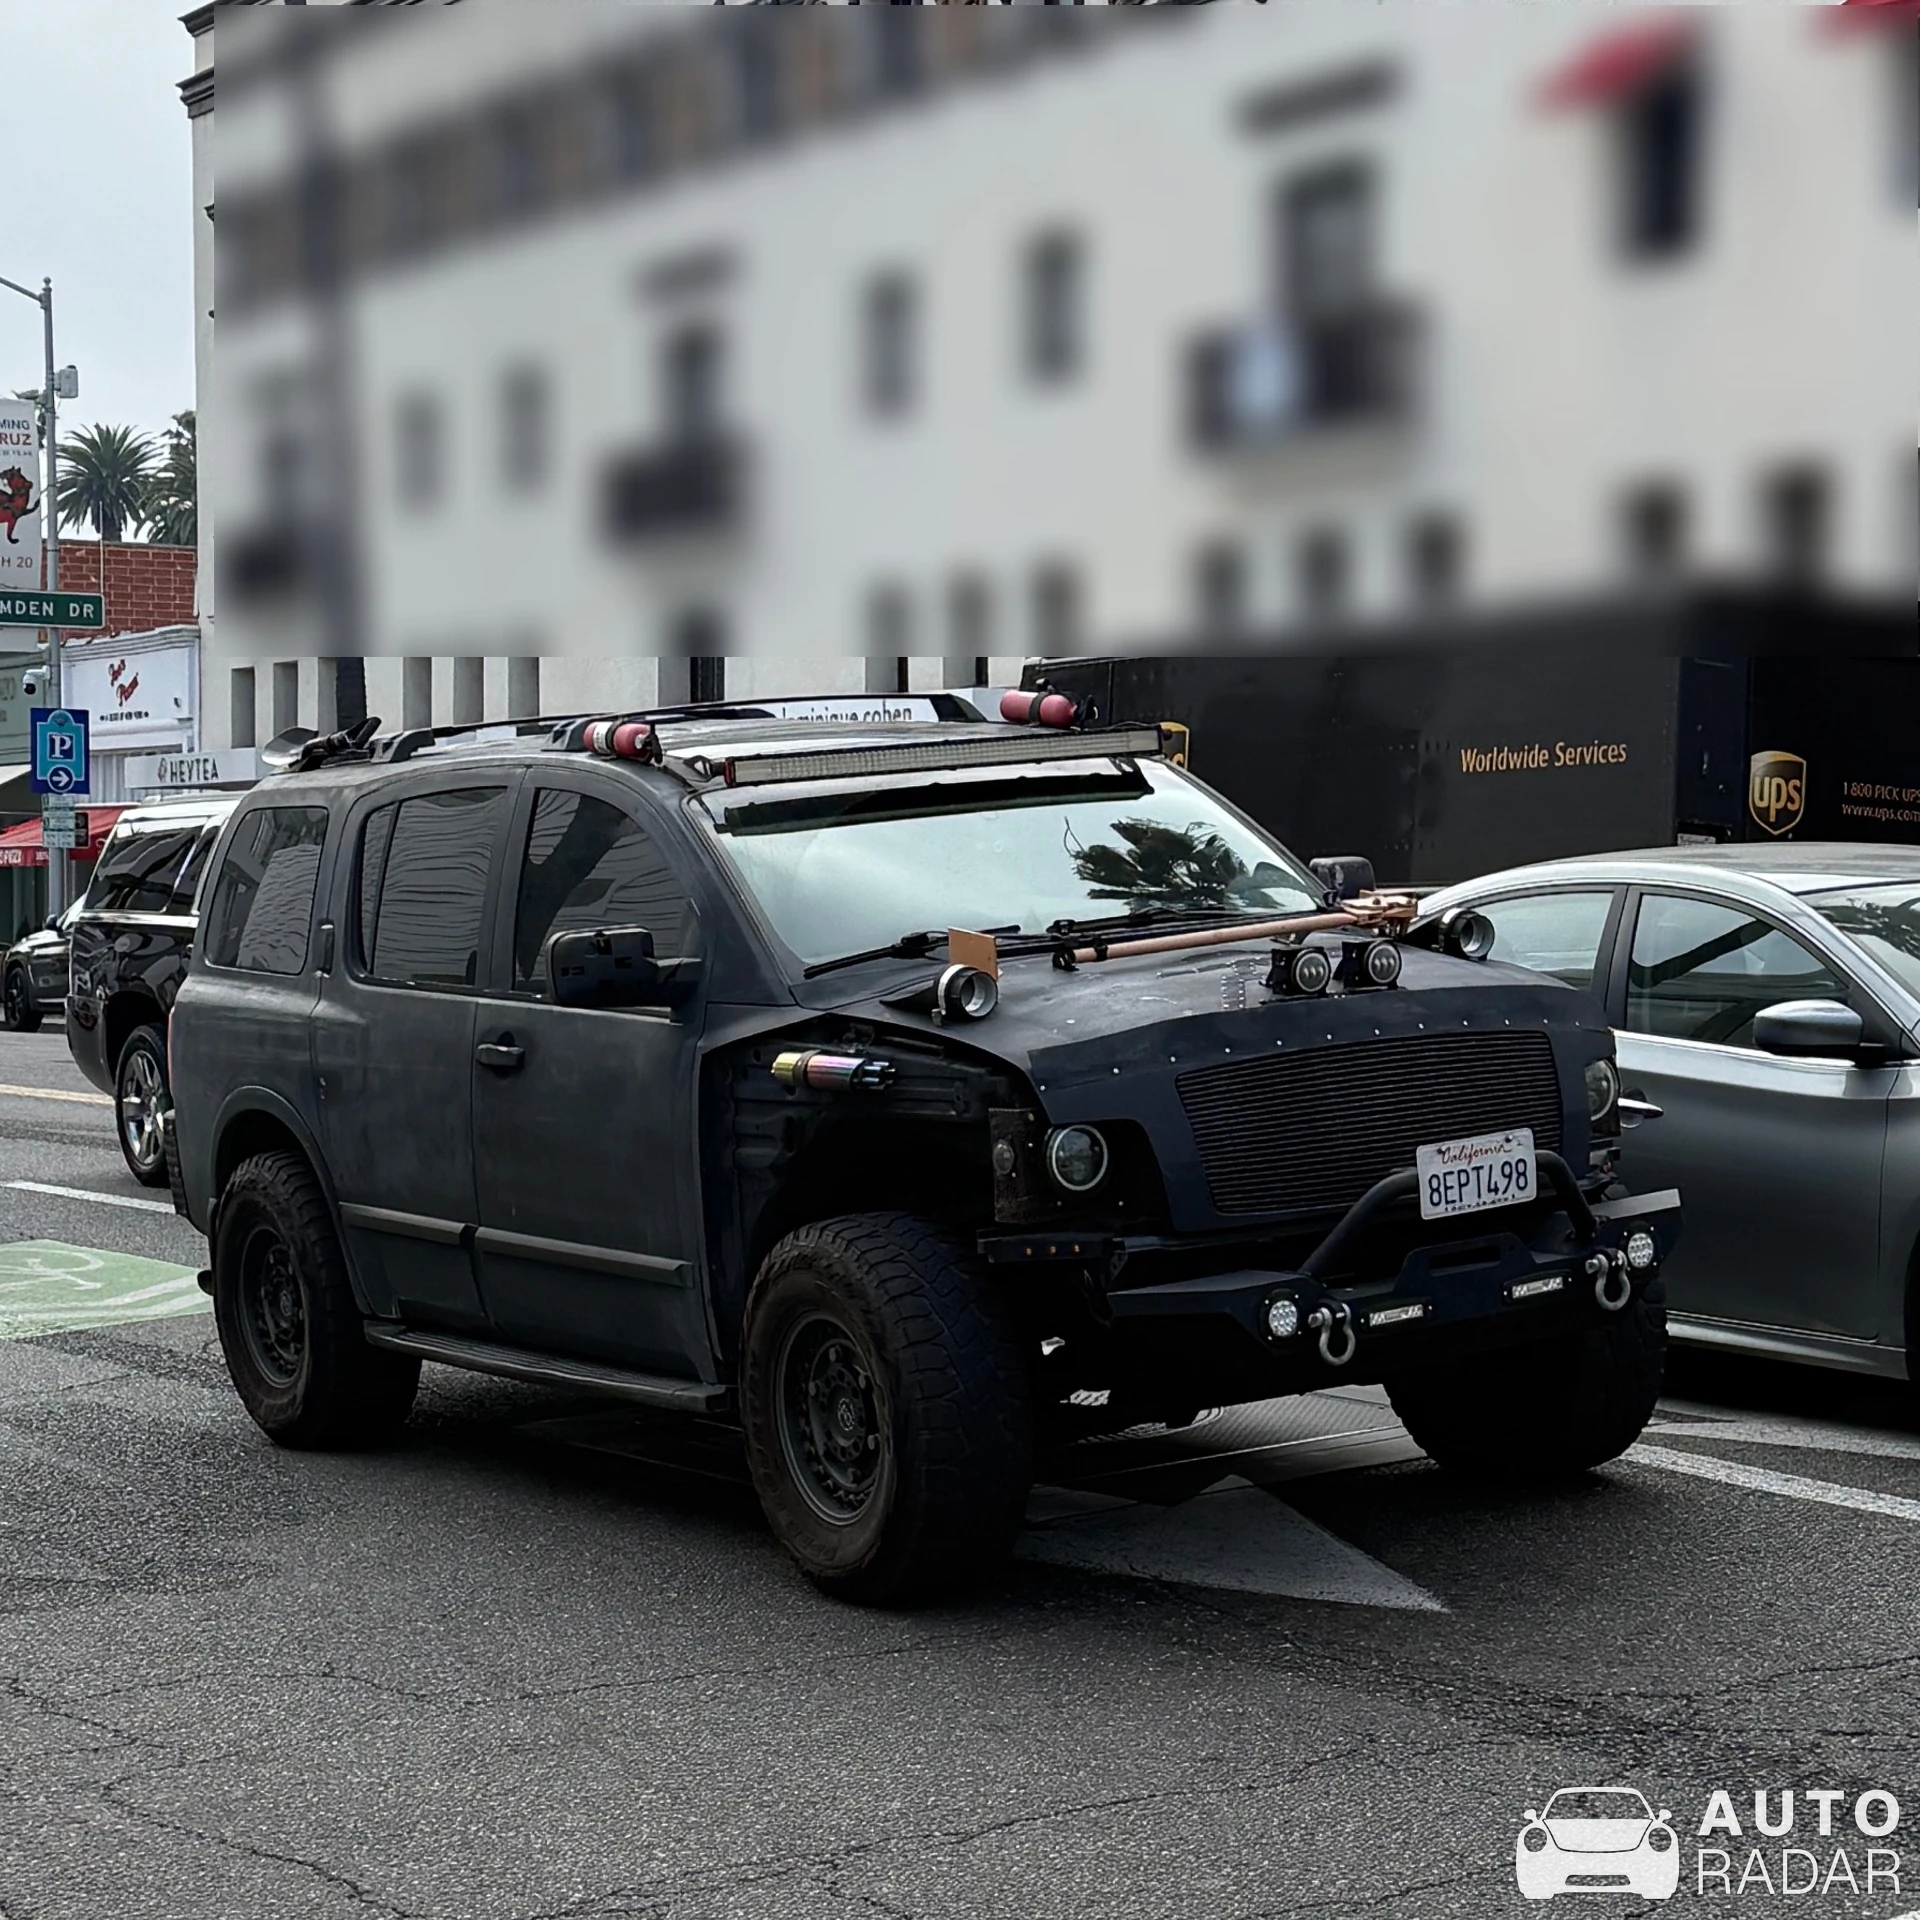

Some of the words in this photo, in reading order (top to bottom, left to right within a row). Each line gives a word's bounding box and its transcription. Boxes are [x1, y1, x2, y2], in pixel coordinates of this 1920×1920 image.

[0, 432, 32, 446] RUZ
[17, 556, 34, 569] 20
[0, 600, 54, 616] MDEN
[69, 603, 94, 618] DR
[51, 735, 72, 758] P
[1461, 744, 1550, 773] Worldwide
[1554, 740, 1628, 767] Services
[169, 757, 219, 783] HEYTEA
[1753, 776, 1801, 822] ups
[1850, 782, 1873, 798] 800
[1874, 784, 1900, 801] PICK
[1439, 1143, 1513, 1166] California
[1428, 1158, 1528, 1207] 8EPT498
